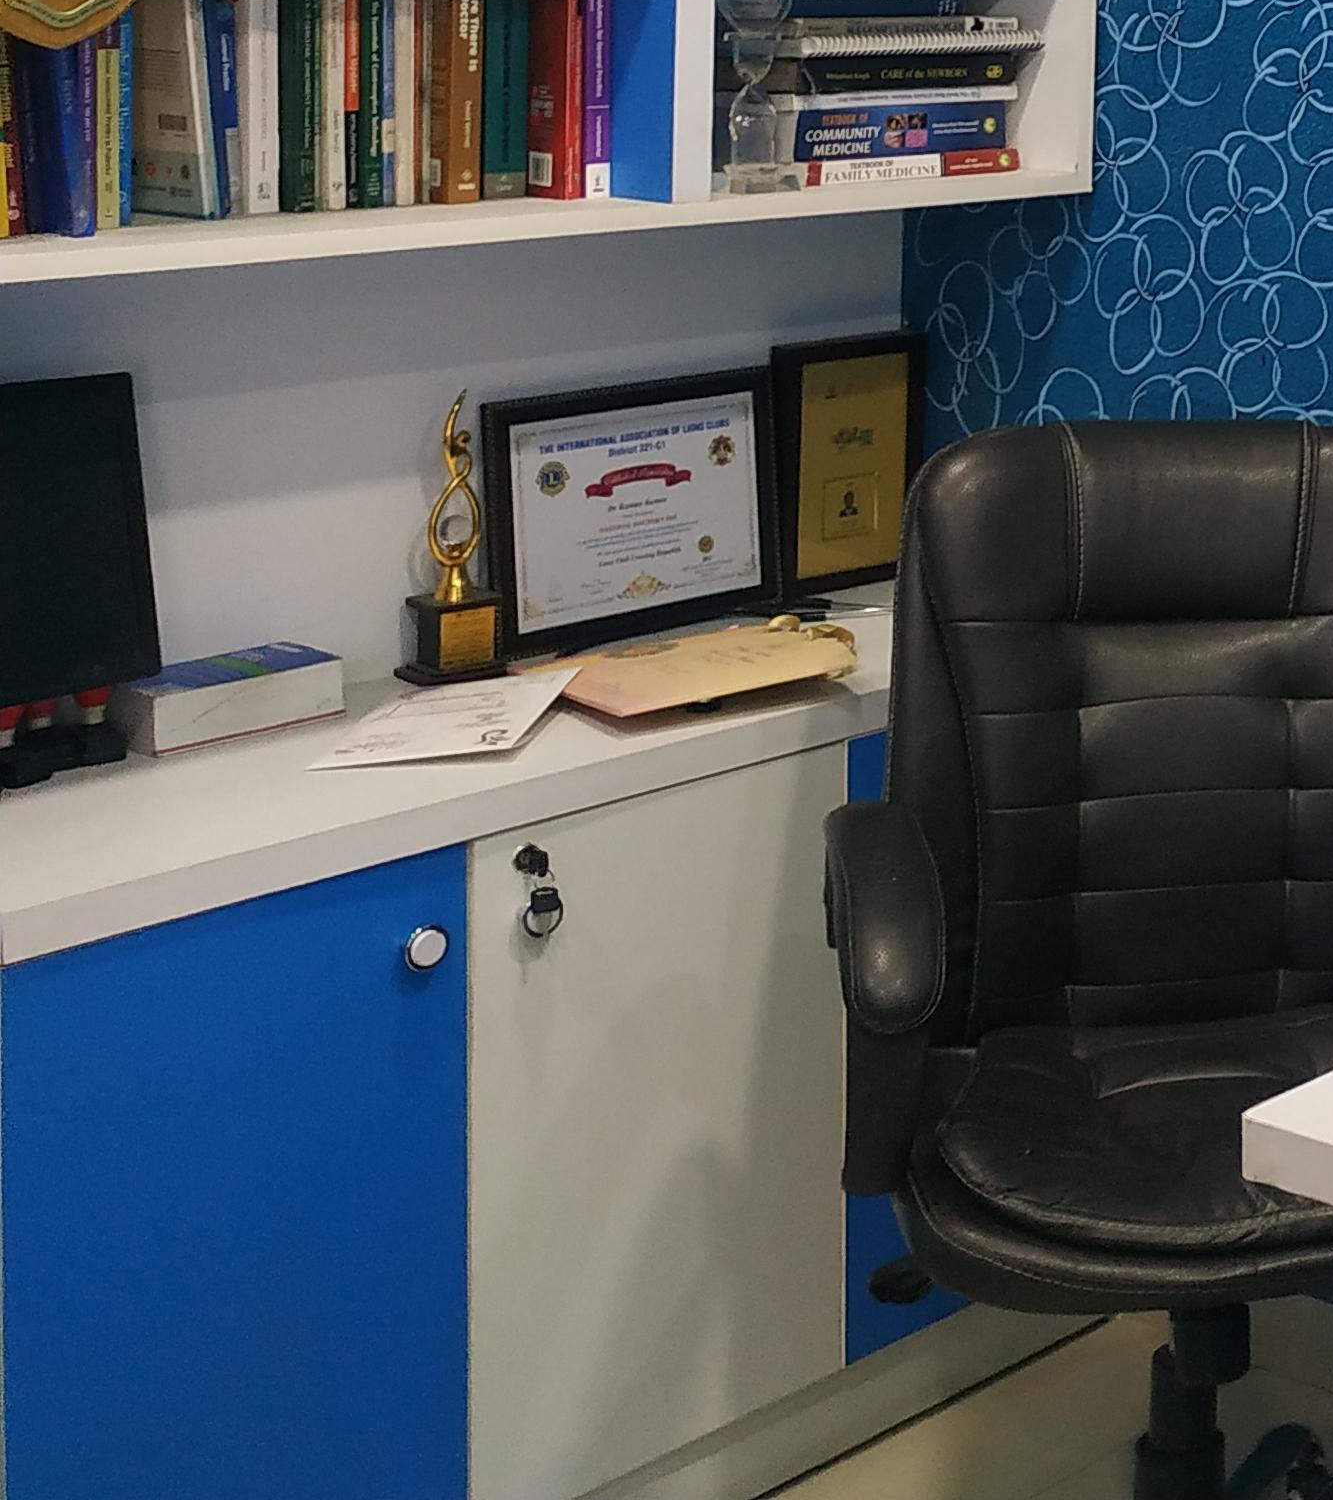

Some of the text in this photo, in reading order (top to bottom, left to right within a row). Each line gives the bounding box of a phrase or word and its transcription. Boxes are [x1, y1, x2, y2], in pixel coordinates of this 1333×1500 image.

[470, 14, 481, 57] There
[880, 68, 905, 79] CARE
[805, 126, 882, 143] COMMUNITY
[812, 141, 872, 157] MEDICINE
[849, 160, 883, 169] TEXTBOOK
[825, 164, 938, 183] FAMILY MEDICINE
[556, 436, 617, 453] INTERNATIONAL
[620, 427, 669, 443] ASSOCIATION
[707, 418, 730, 430] CLUBS
